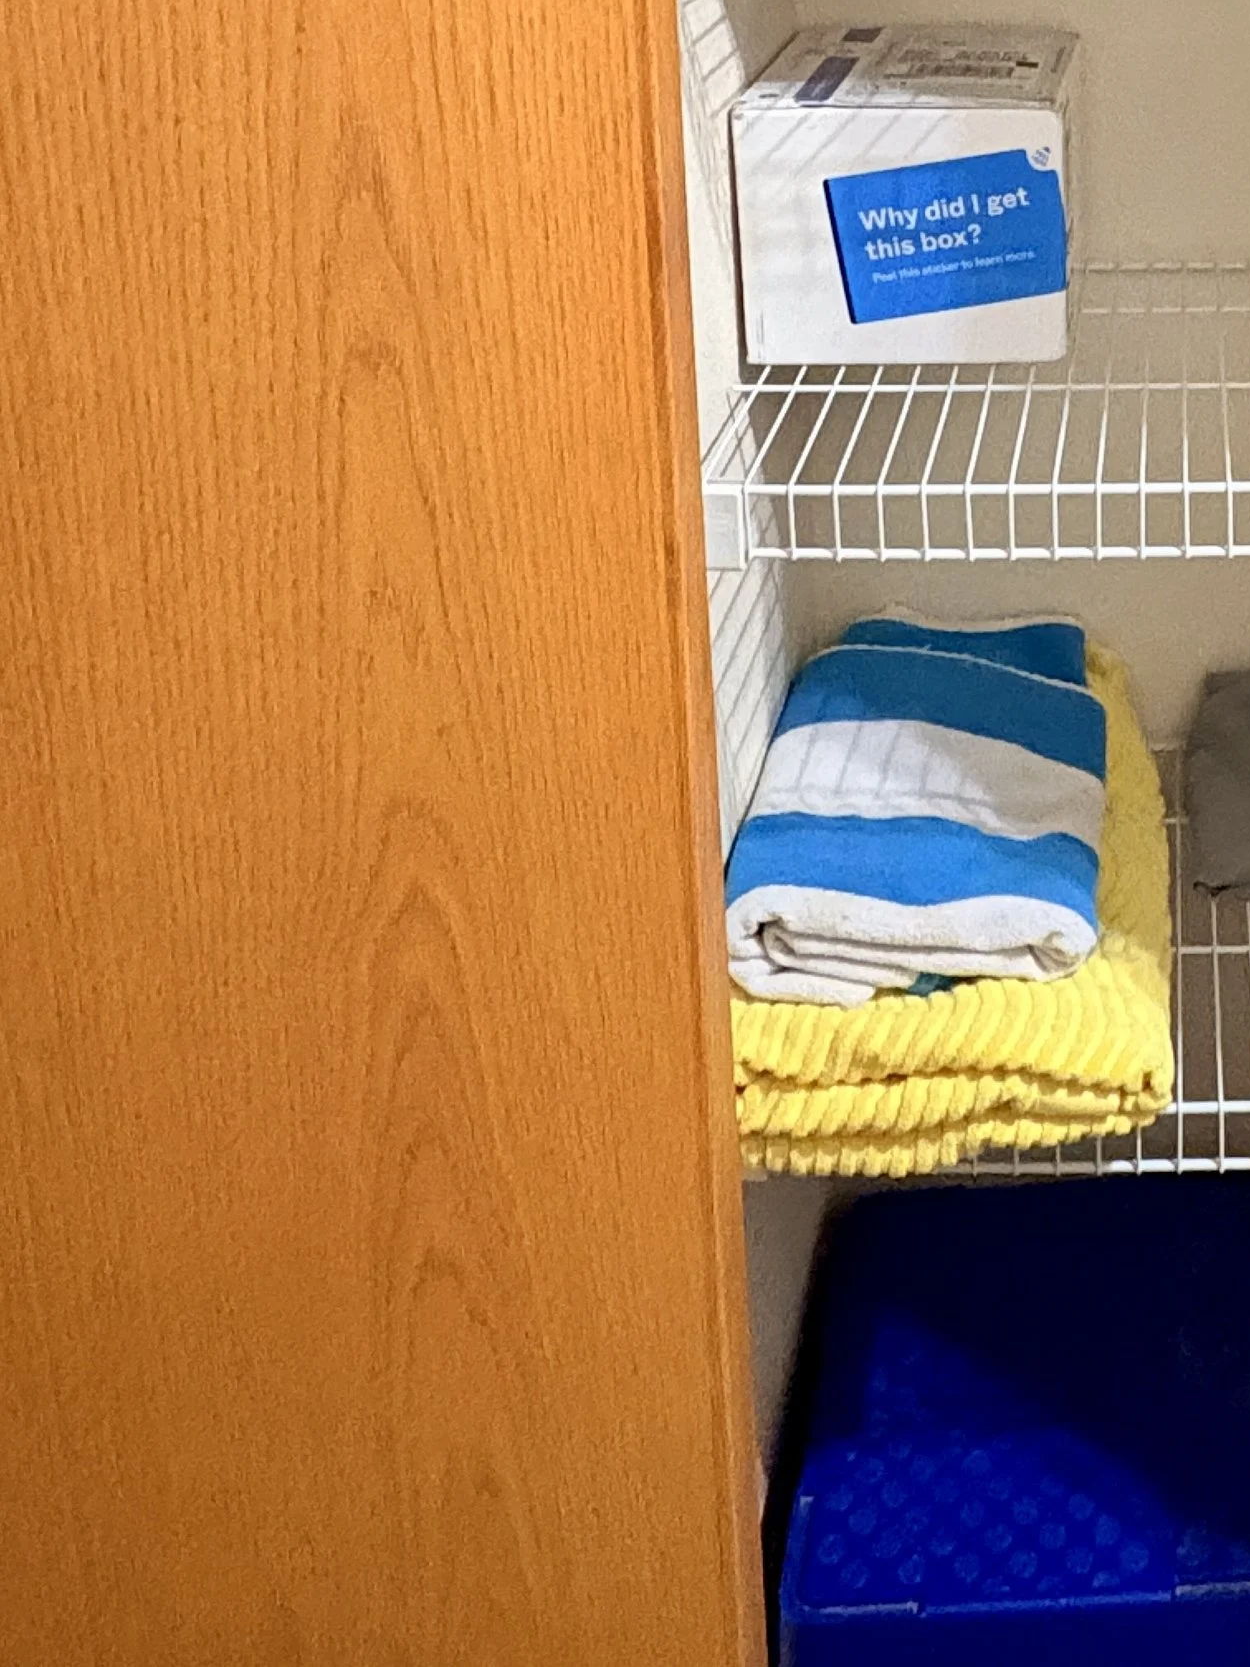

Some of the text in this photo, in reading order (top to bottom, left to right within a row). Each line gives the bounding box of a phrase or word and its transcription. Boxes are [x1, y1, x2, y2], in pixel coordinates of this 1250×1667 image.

[858, 186, 1030, 231] Why did I get
[864, 223, 981, 260] this box?
